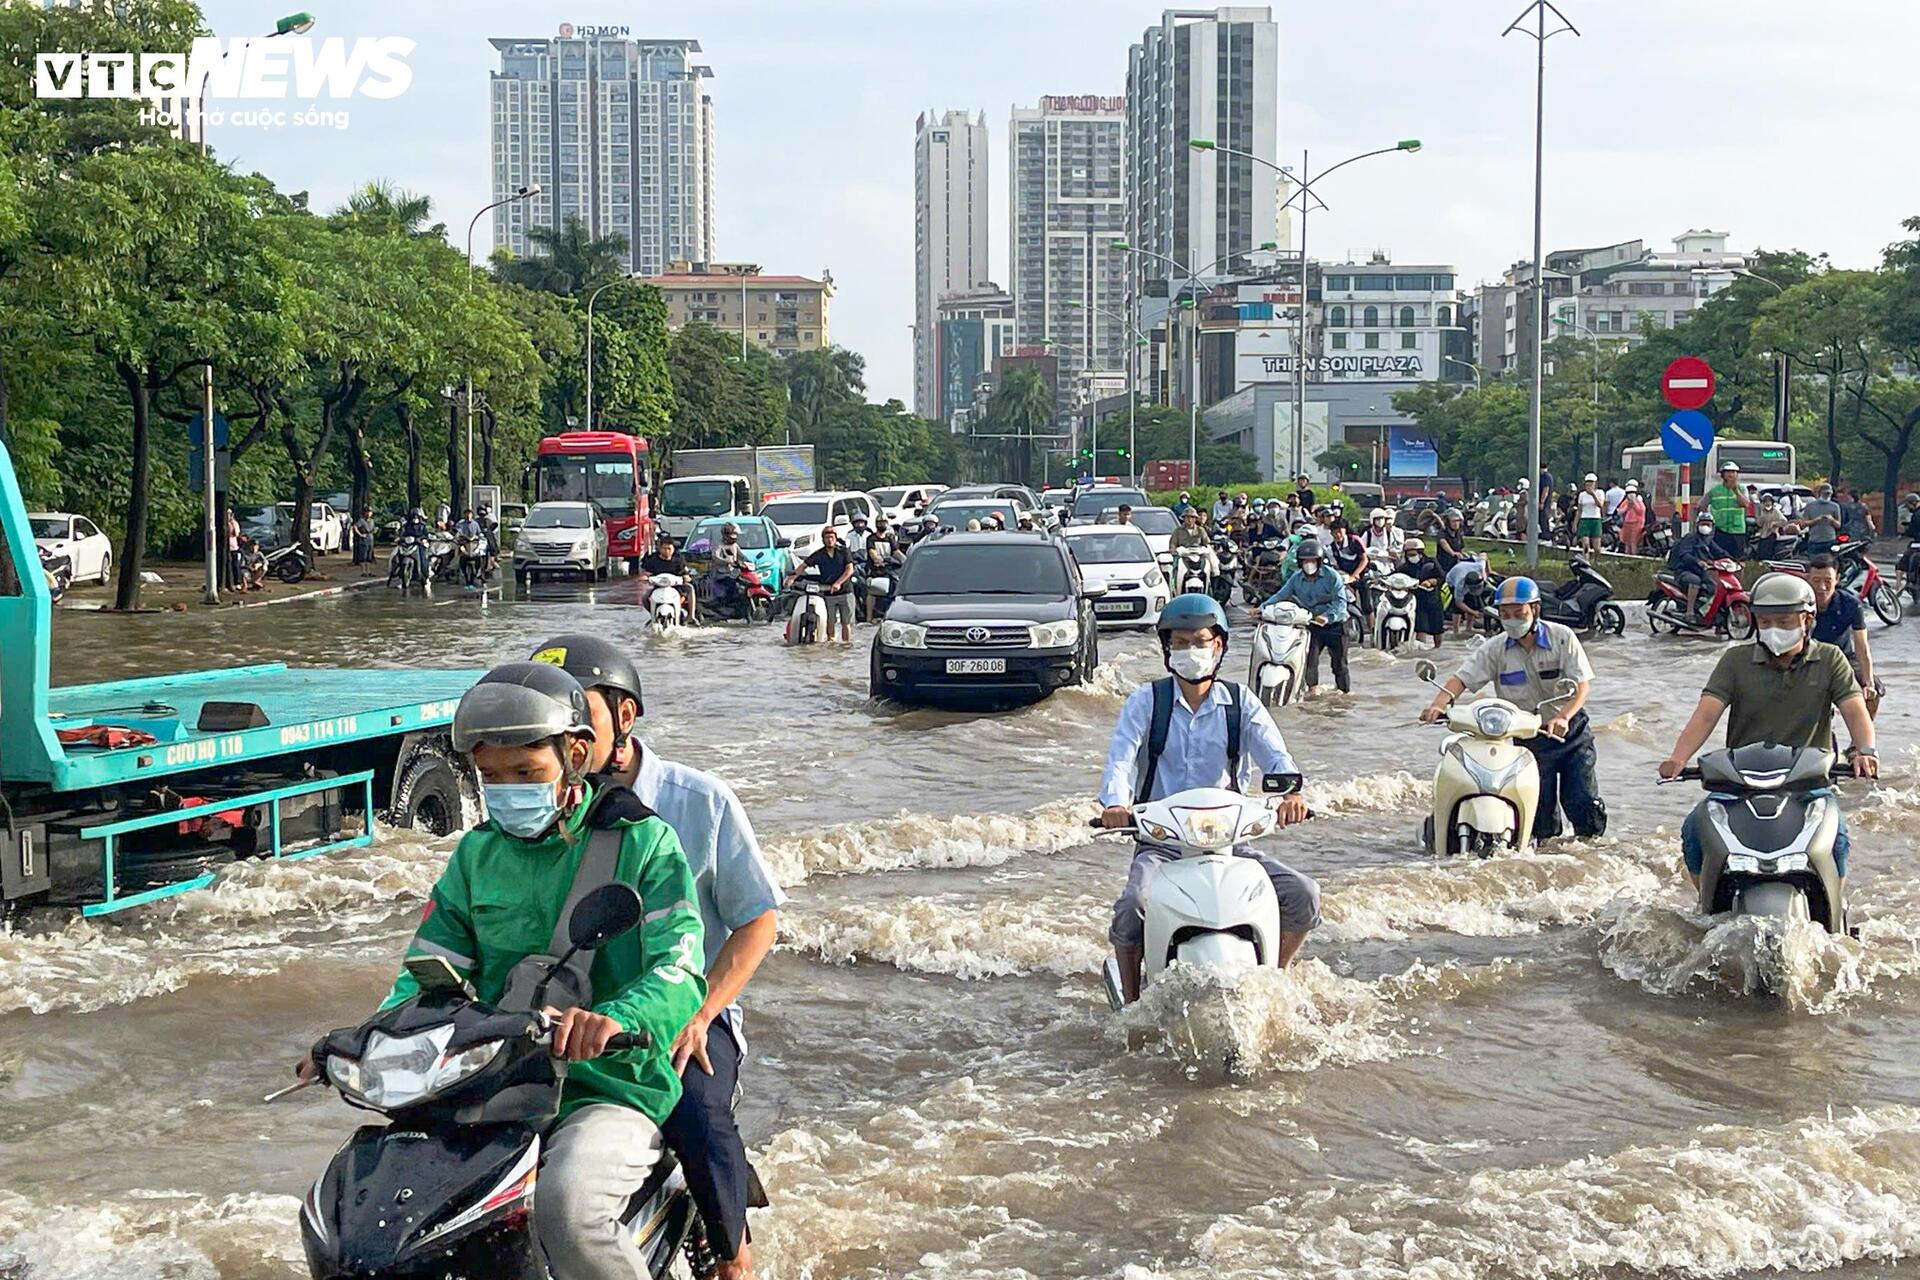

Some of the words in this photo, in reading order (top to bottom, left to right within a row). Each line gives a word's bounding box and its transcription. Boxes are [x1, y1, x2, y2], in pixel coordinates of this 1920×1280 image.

[577, 25, 596, 36] HD
[598, 25, 630, 36] MON
[1318, 356, 1357, 372] SON
[1361, 356, 1423, 372] PLAZA
[281, 724, 310, 746] 0943
